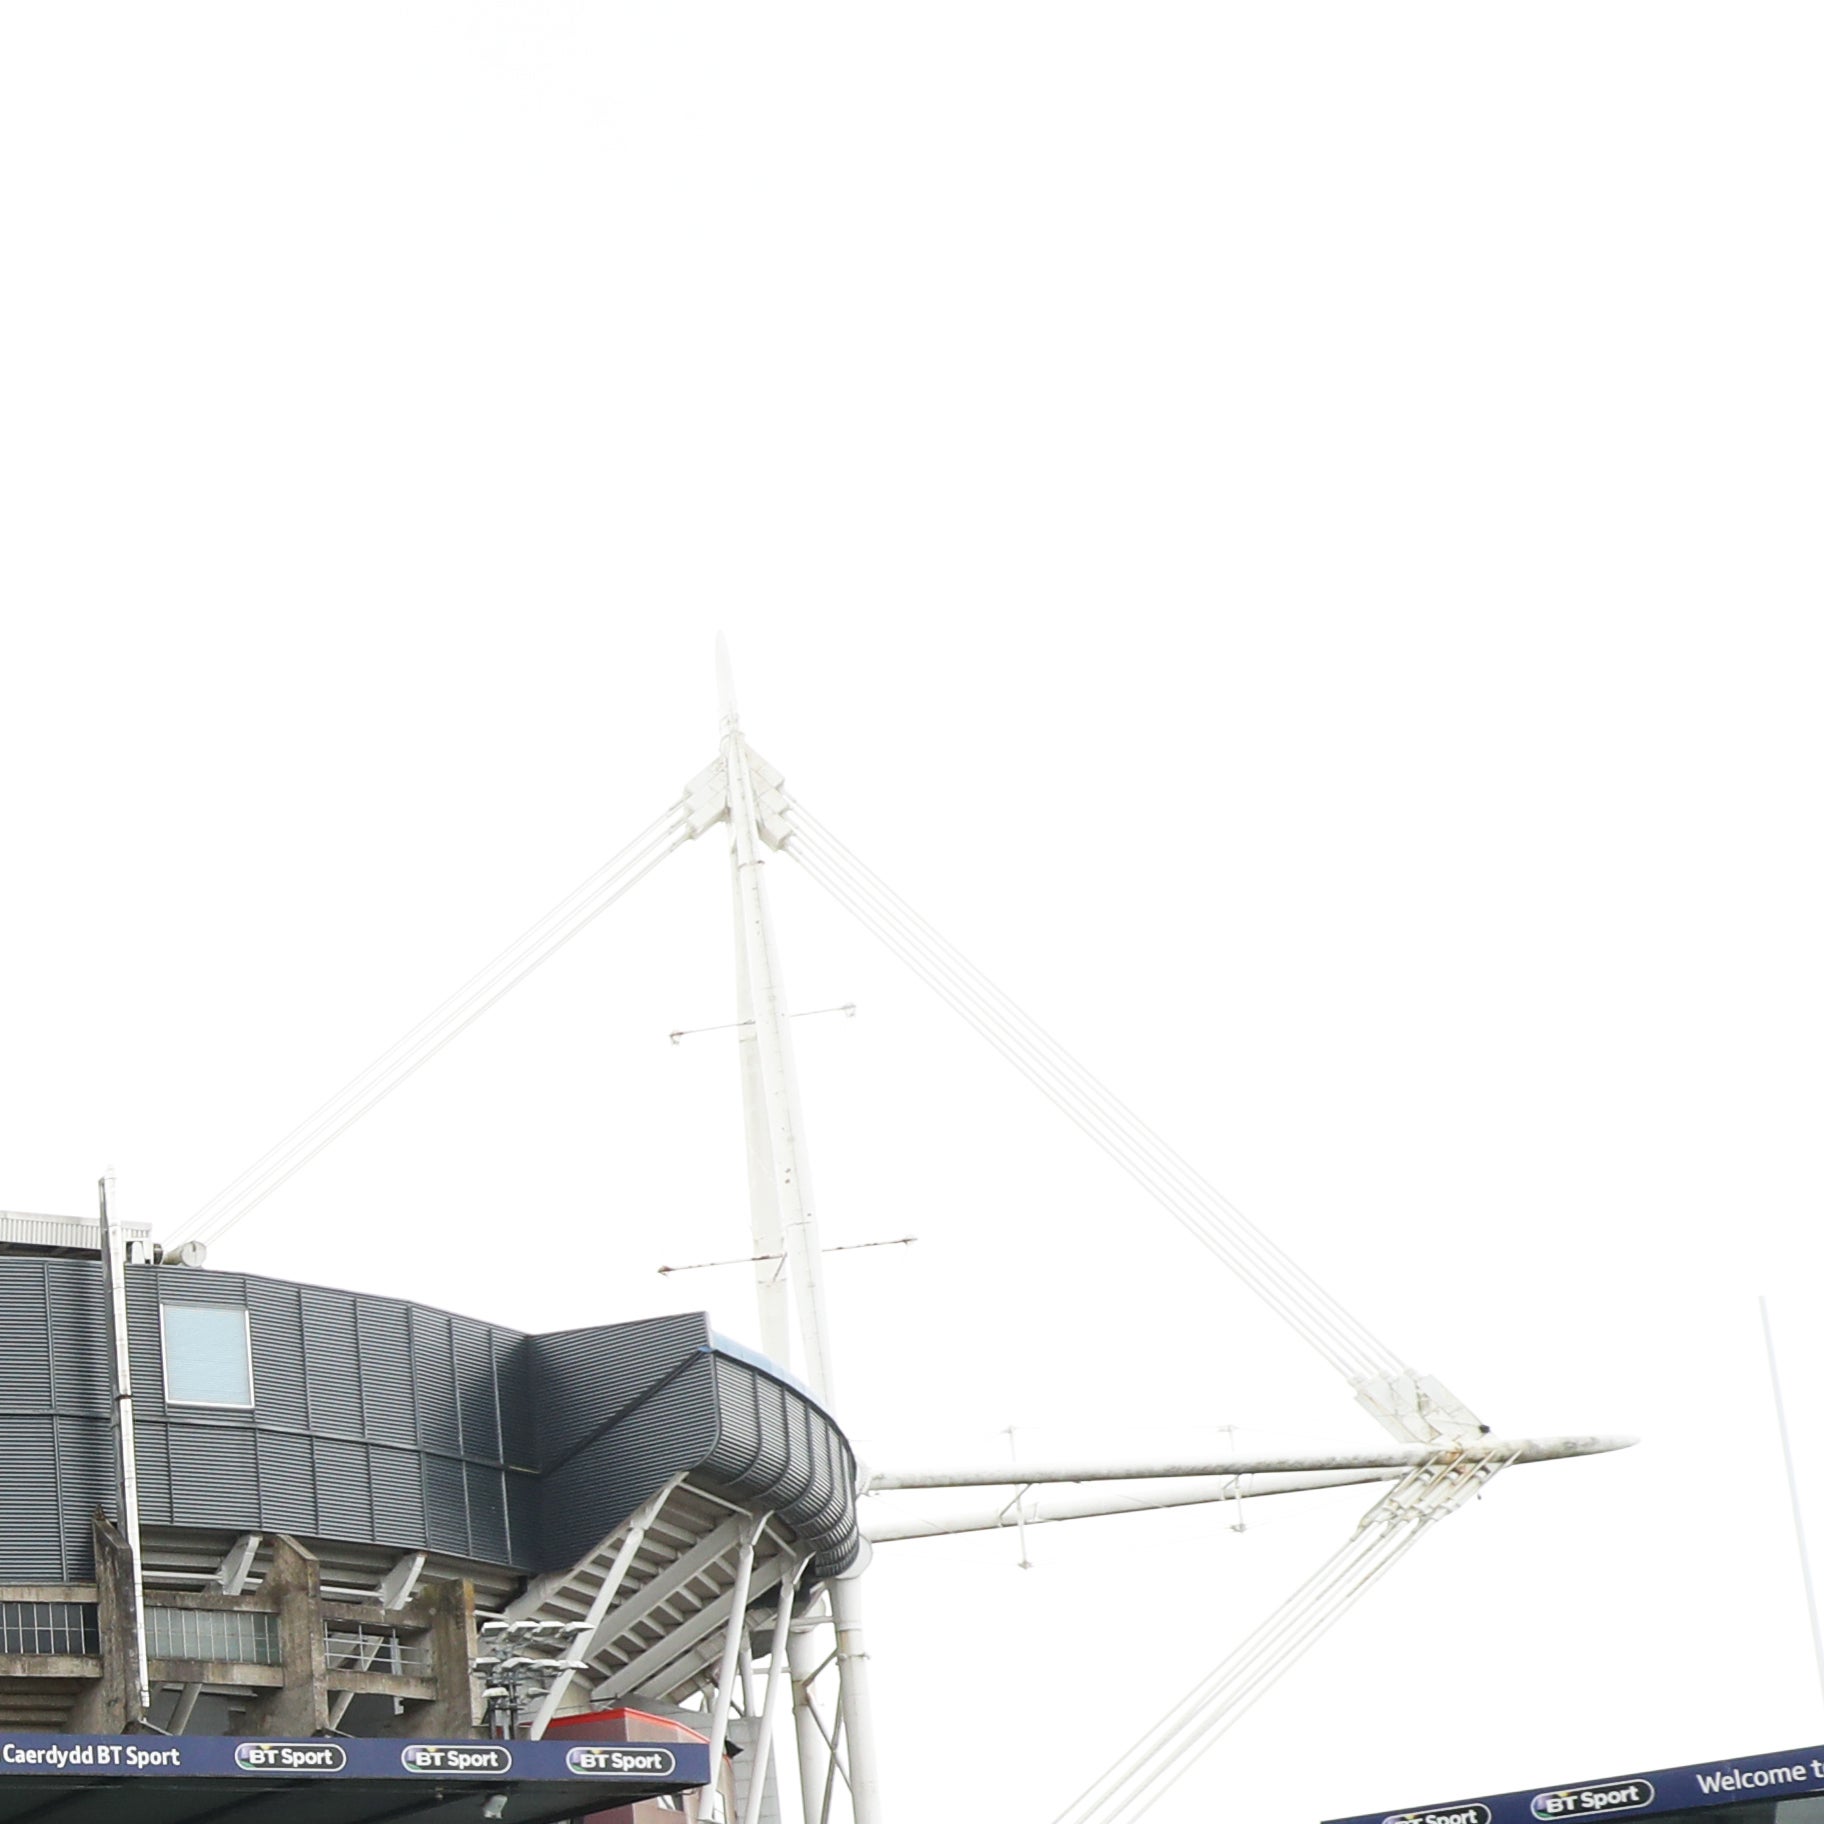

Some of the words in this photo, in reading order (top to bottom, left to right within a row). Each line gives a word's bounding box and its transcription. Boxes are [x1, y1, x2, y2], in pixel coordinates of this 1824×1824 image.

[3, 1744, 94, 1768] Caerdydd
[97, 1746, 123, 1764] BT
[126, 1746, 181, 1768] Sport
[250, 1750, 279, 1765] BT
[281, 1749, 333, 1767] Sport
[415, 1752, 446, 1768] BT
[448, 1751, 499, 1769] Sport
[580, 1754, 610, 1769] BT
[611, 1753, 663, 1771] Sport
[1696, 1765, 1808, 1795] Welcome
[1546, 1794, 1578, 1814] BT
[1580, 1786, 1640, 1809] Sport
